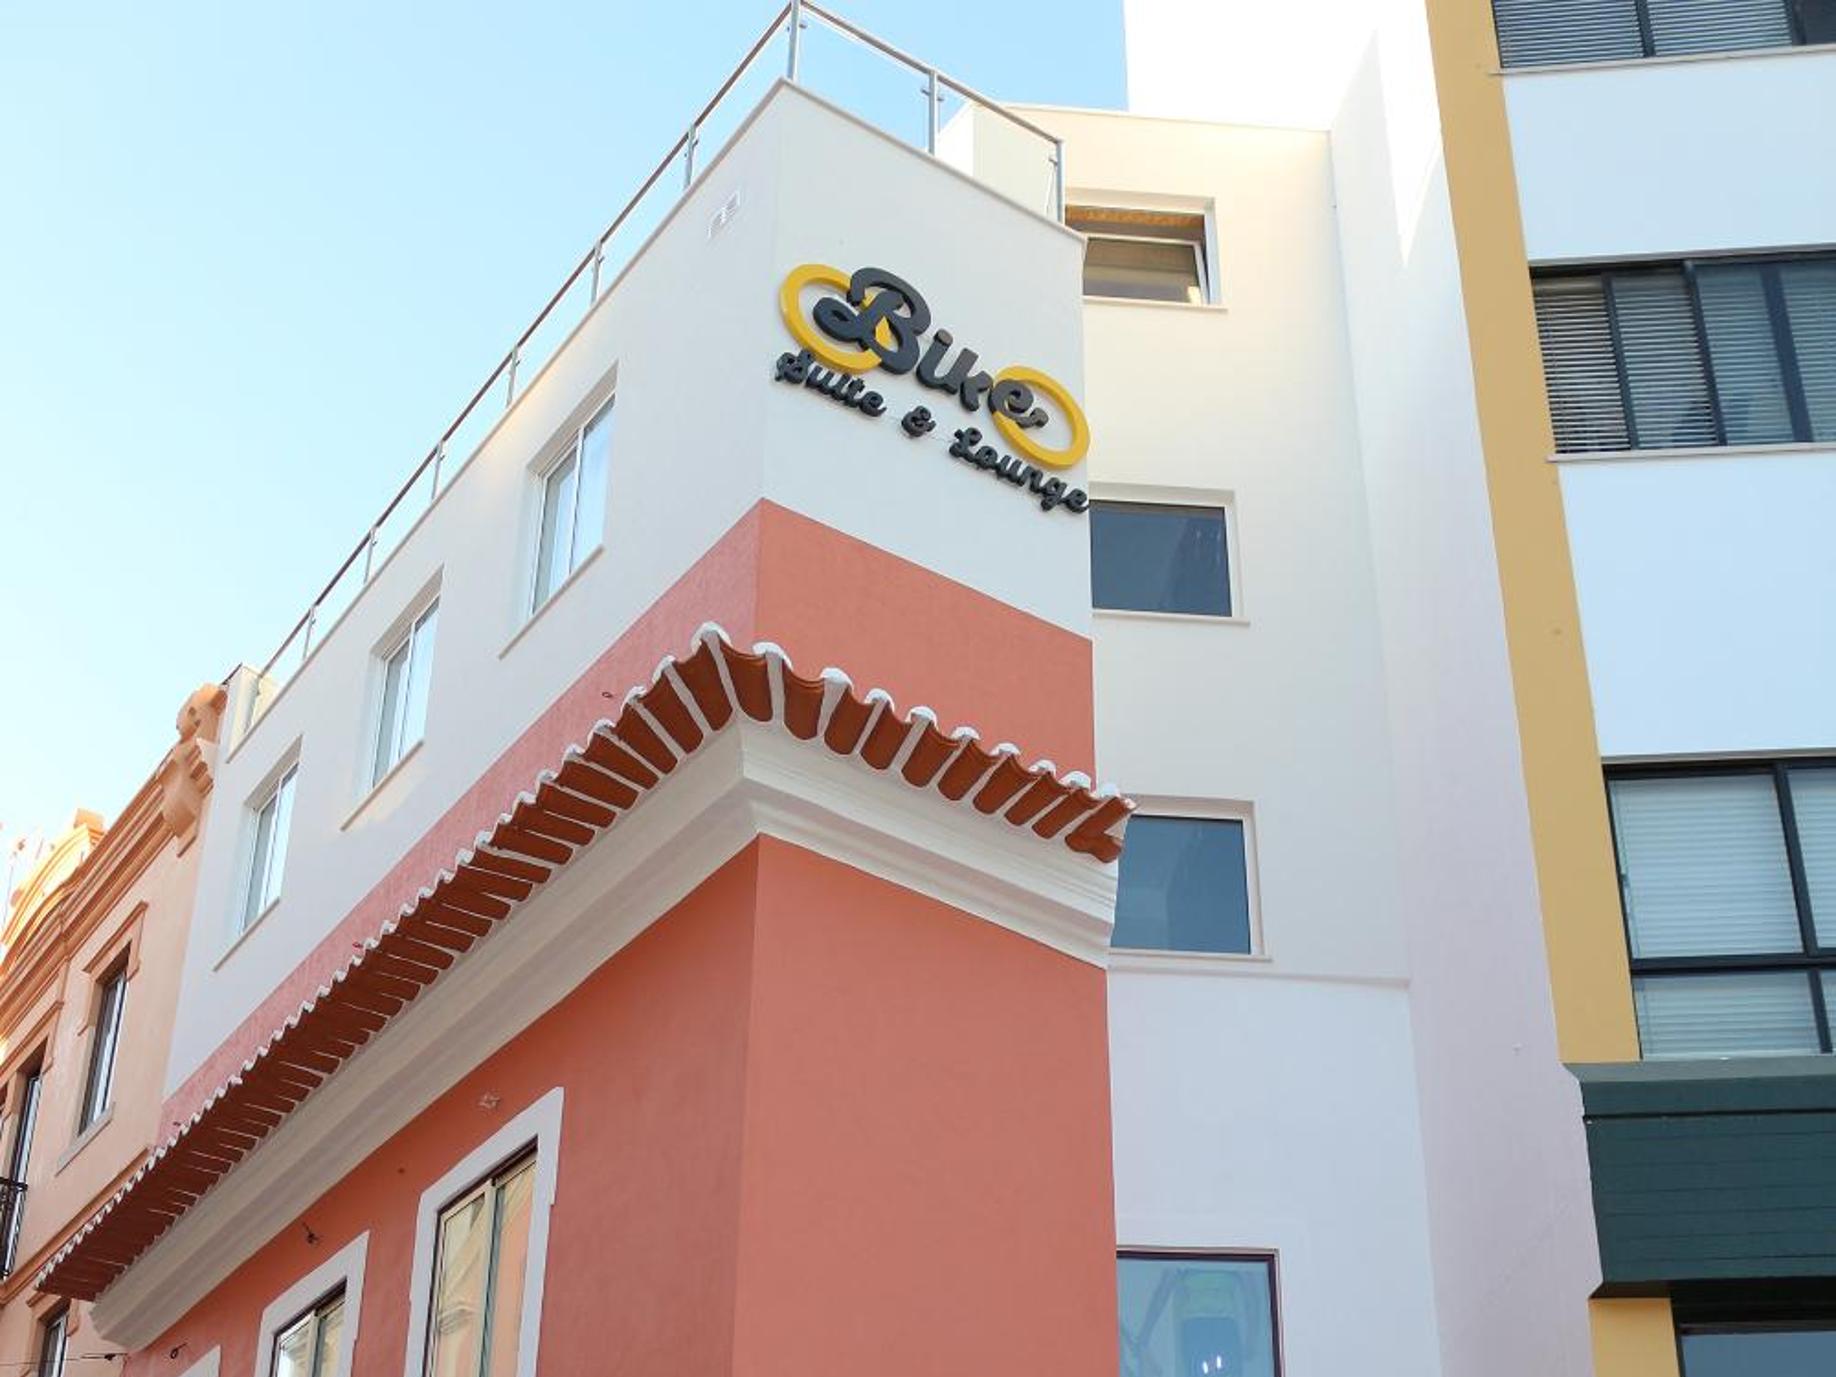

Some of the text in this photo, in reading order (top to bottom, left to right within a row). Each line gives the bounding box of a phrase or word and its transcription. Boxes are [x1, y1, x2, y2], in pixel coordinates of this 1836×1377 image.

[812, 267, 1049, 428] Bike
[774, 349, 1091, 514] Suite & Lounge
